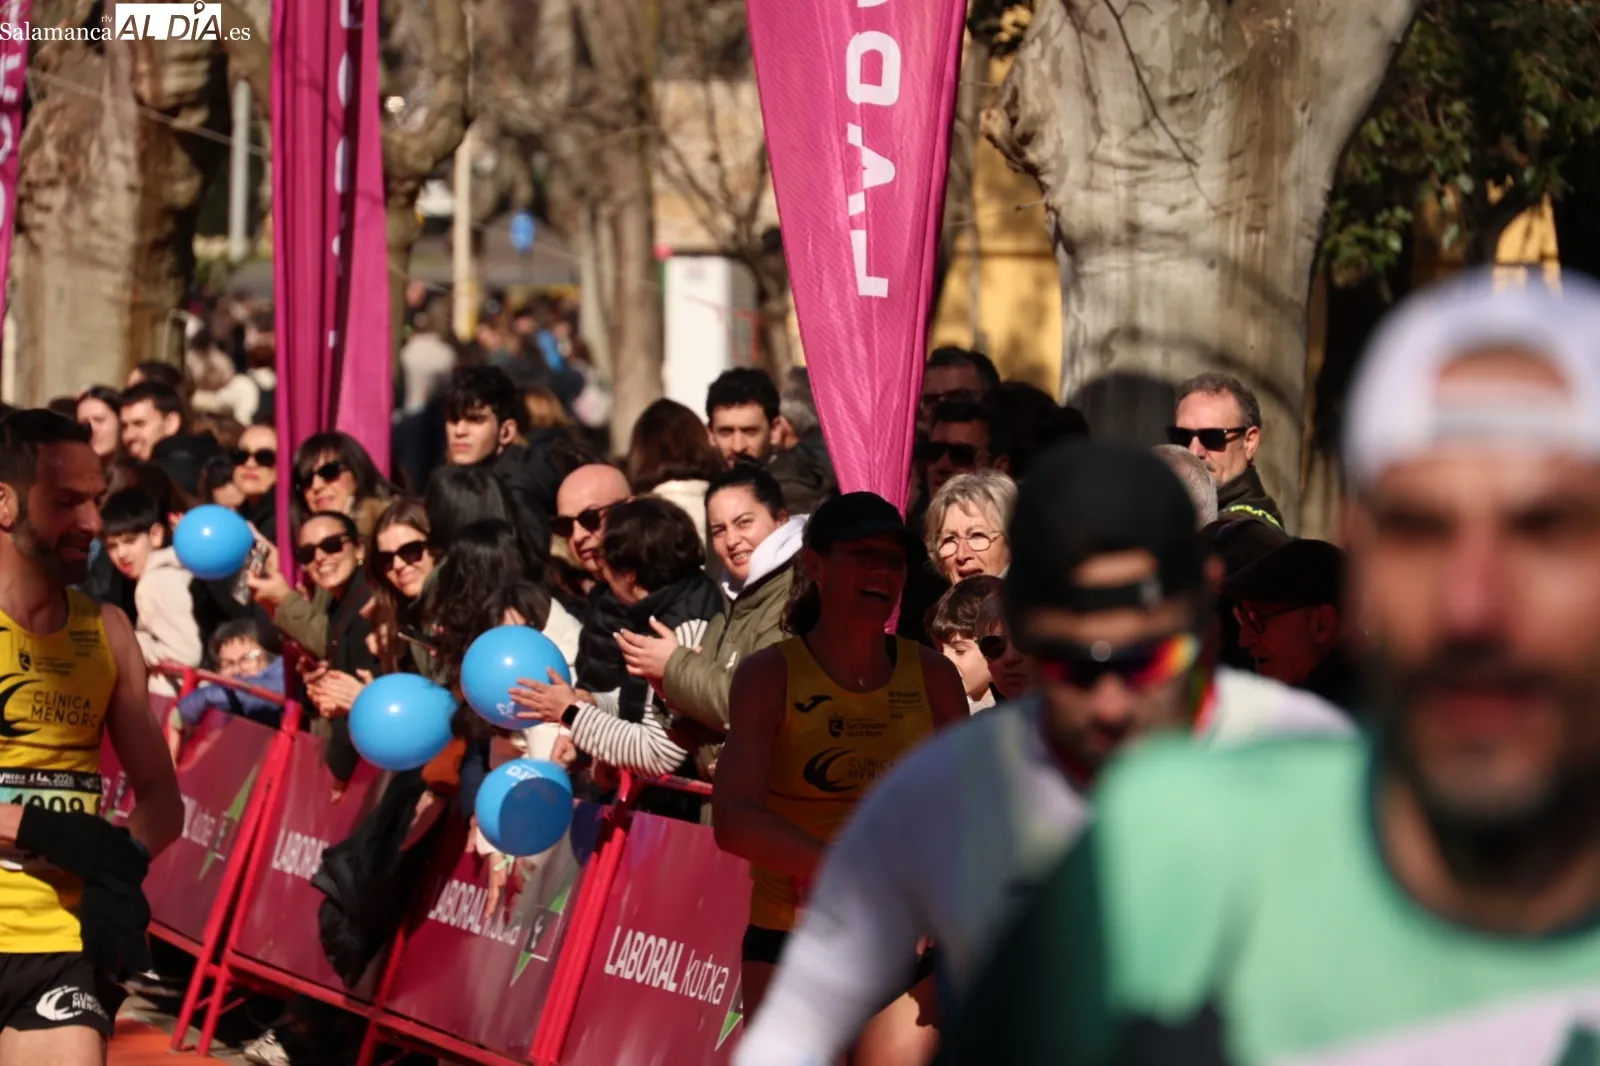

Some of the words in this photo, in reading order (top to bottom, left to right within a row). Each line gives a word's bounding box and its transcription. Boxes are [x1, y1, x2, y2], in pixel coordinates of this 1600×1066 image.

[271, 827, 329, 881] LABORA
[604, 925, 684, 992] LABORAL
[679, 949, 730, 1006] kutxa
